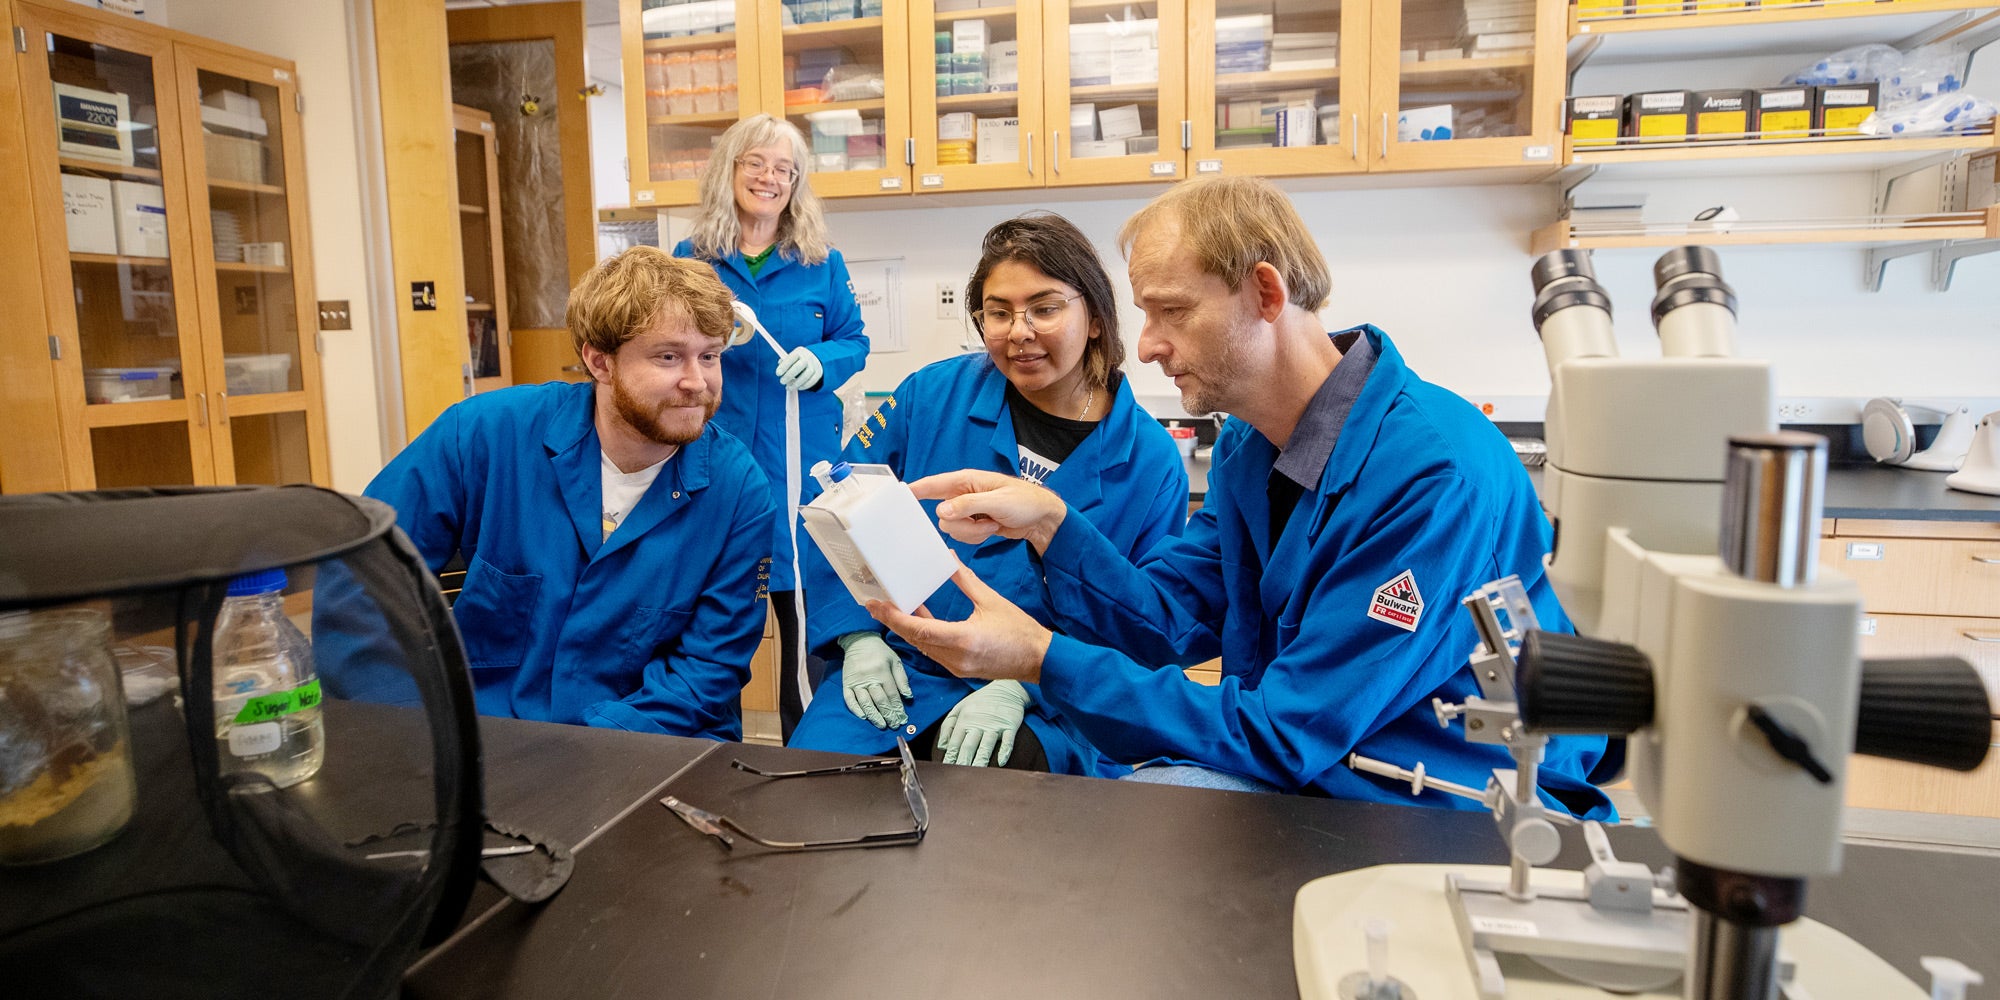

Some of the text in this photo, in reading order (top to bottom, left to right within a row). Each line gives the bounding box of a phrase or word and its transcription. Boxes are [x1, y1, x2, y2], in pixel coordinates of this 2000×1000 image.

[86, 111, 117, 126] 2200
[1375, 606, 1387, 615] FR
[1376, 594, 1419, 616] Bulwark
